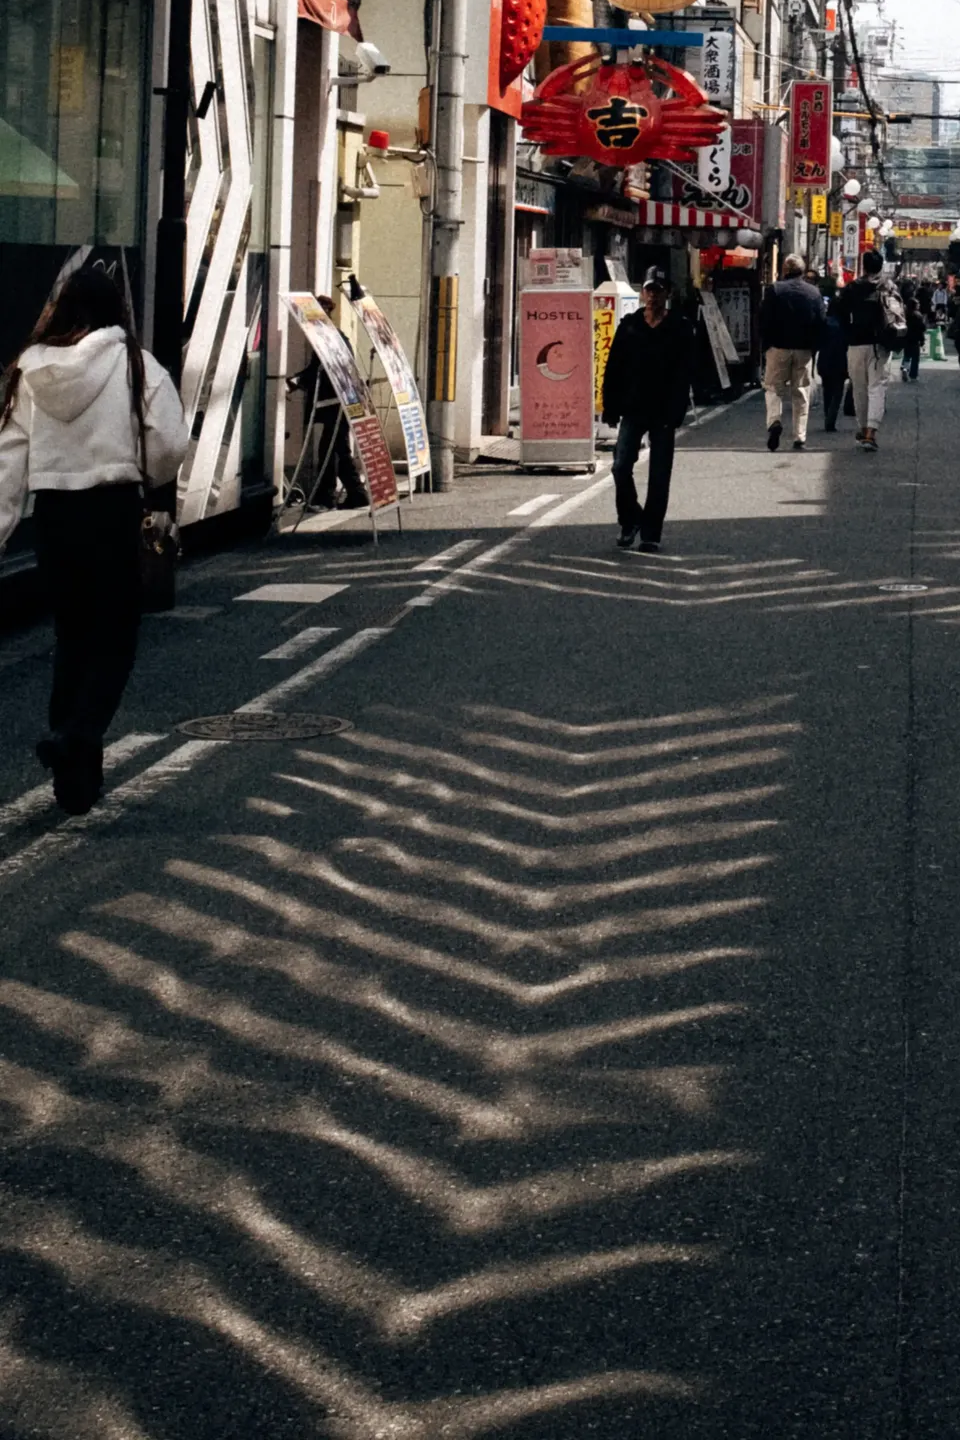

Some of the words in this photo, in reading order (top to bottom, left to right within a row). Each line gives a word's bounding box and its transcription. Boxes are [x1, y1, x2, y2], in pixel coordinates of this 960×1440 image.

[704, 36, 720, 95] 大衆酒場
[587, 97, 649, 150] 吉
[708, 139, 725, 186] ぐら
[526, 310, 584, 321] HOSTEL
